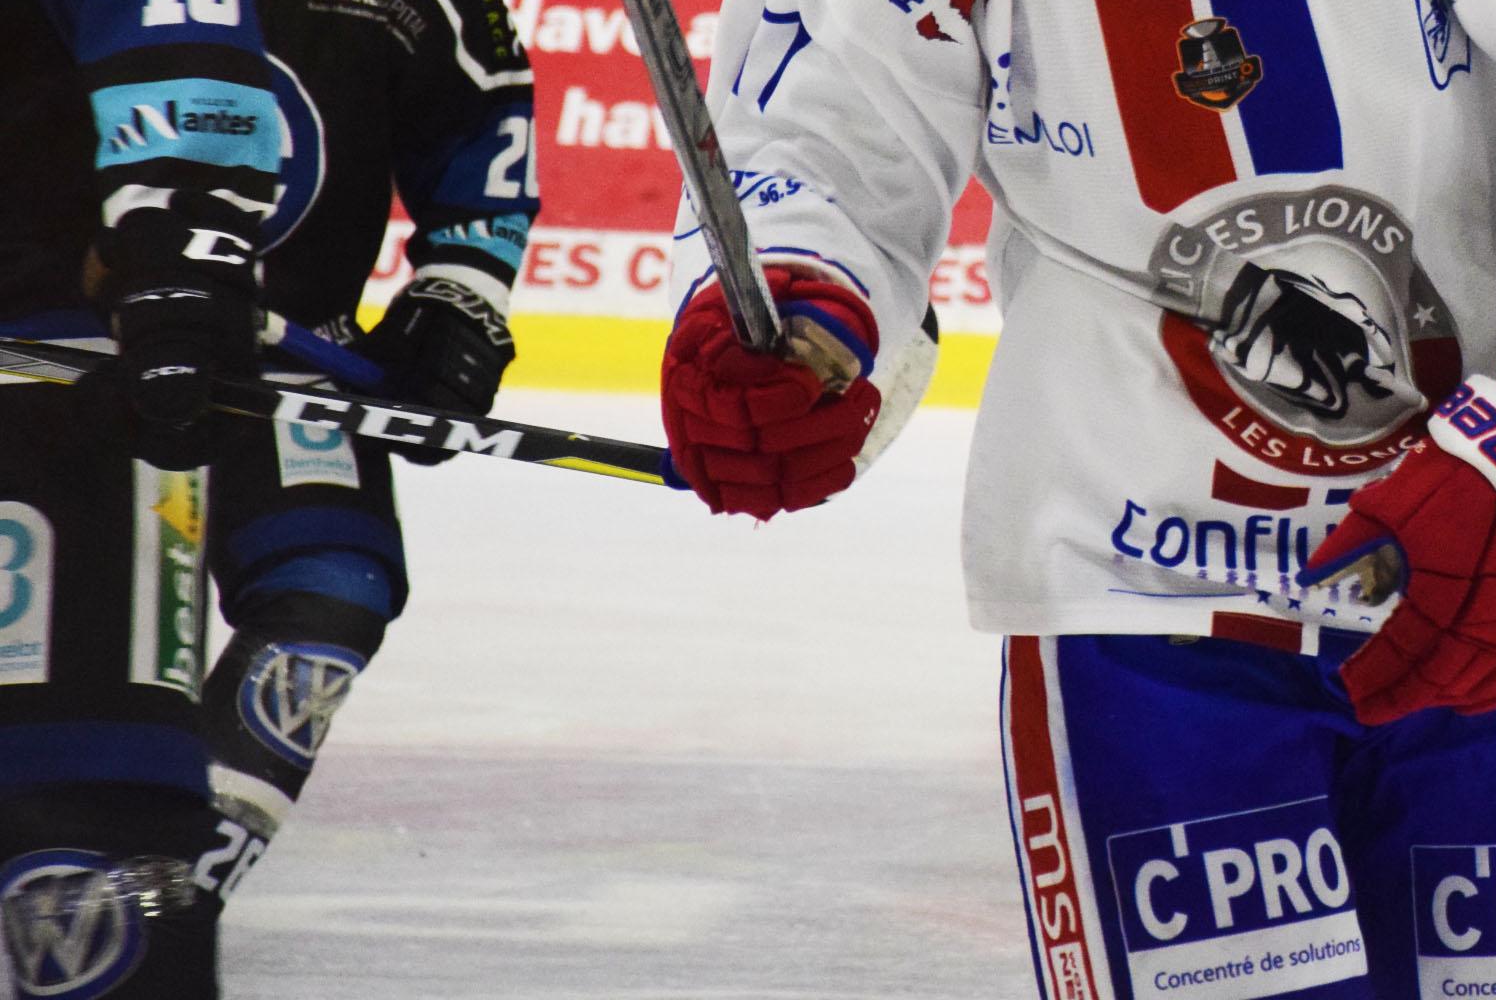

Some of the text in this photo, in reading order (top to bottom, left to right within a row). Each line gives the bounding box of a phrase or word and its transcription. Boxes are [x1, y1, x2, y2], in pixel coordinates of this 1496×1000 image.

[1285, 197, 1404, 254] LIONS
[273, 390, 524, 459] CCM
[1222, 406, 1287, 459] LES
[1154, 937, 1361, 990] Concentré de solutions
